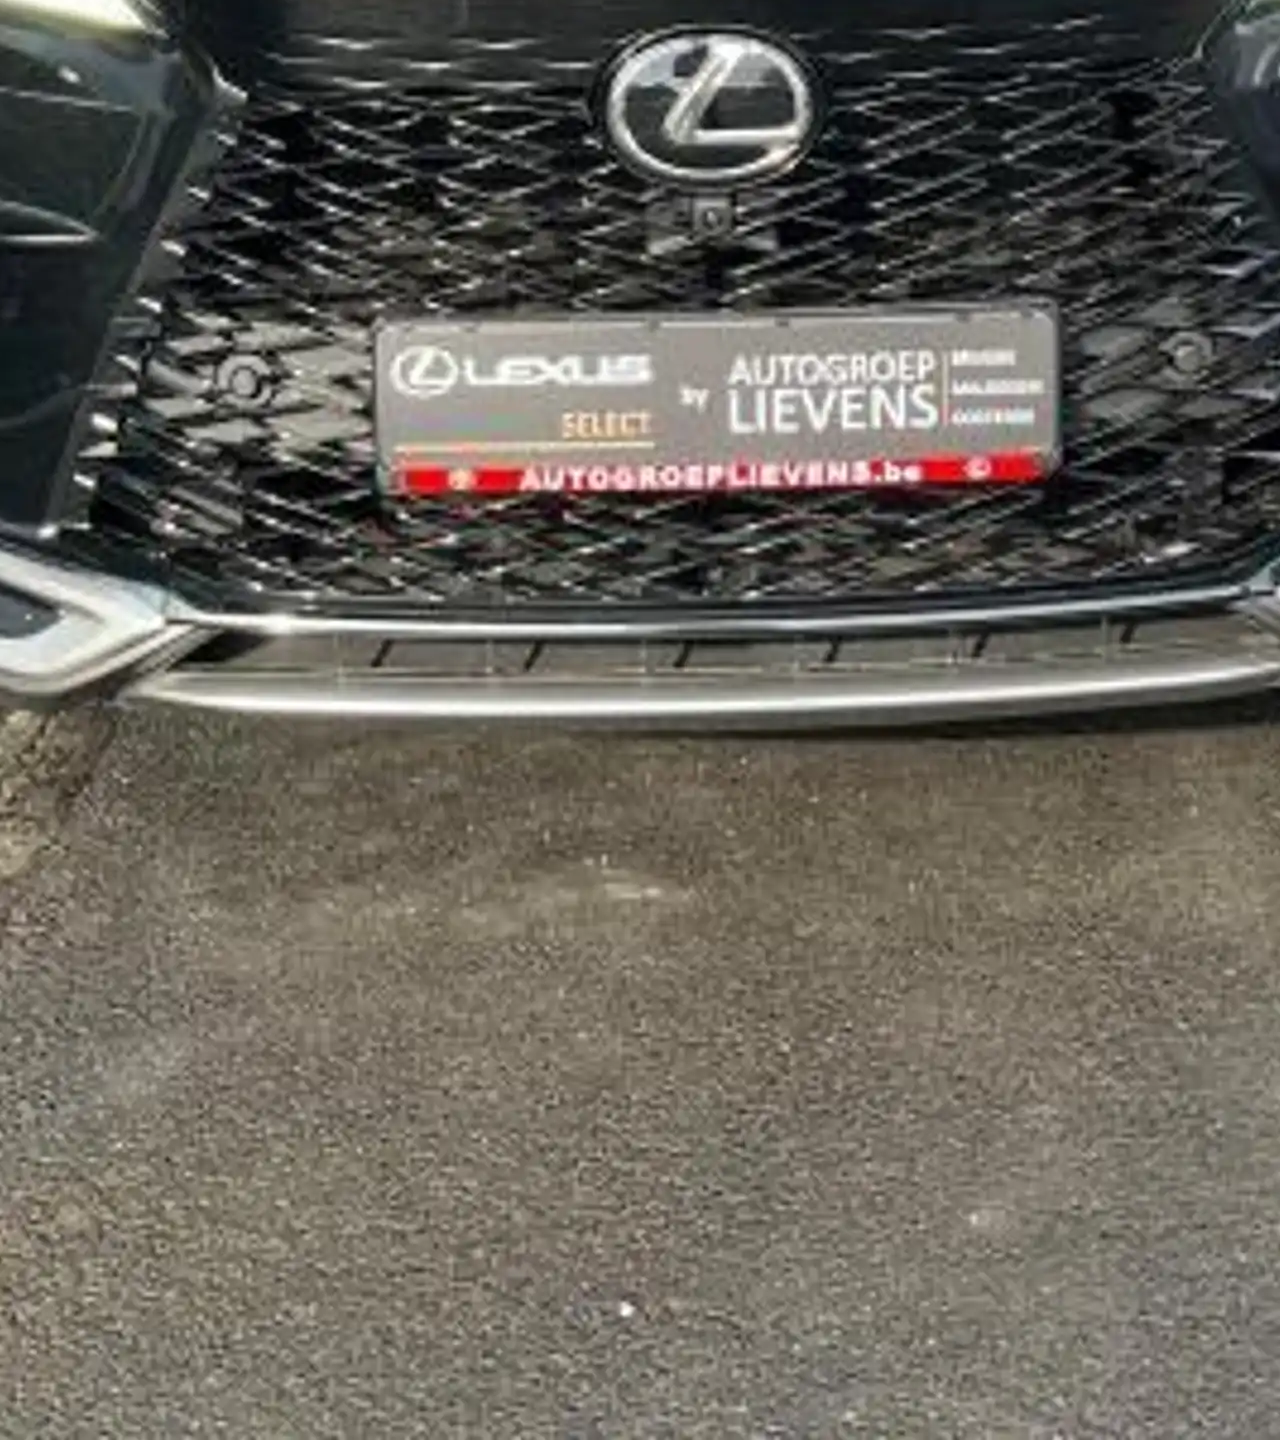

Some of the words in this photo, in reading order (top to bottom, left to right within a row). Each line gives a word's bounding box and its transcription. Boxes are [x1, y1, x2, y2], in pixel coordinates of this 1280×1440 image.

[462, 353, 654, 387] LEXUS
[726, 348, 936, 387] AUTOGROEP
[561, 410, 652, 440] SELECT
[727, 383, 939, 435] LIEVENS
[519, 459, 924, 493] AUTOGROEPLIEVENS.be
